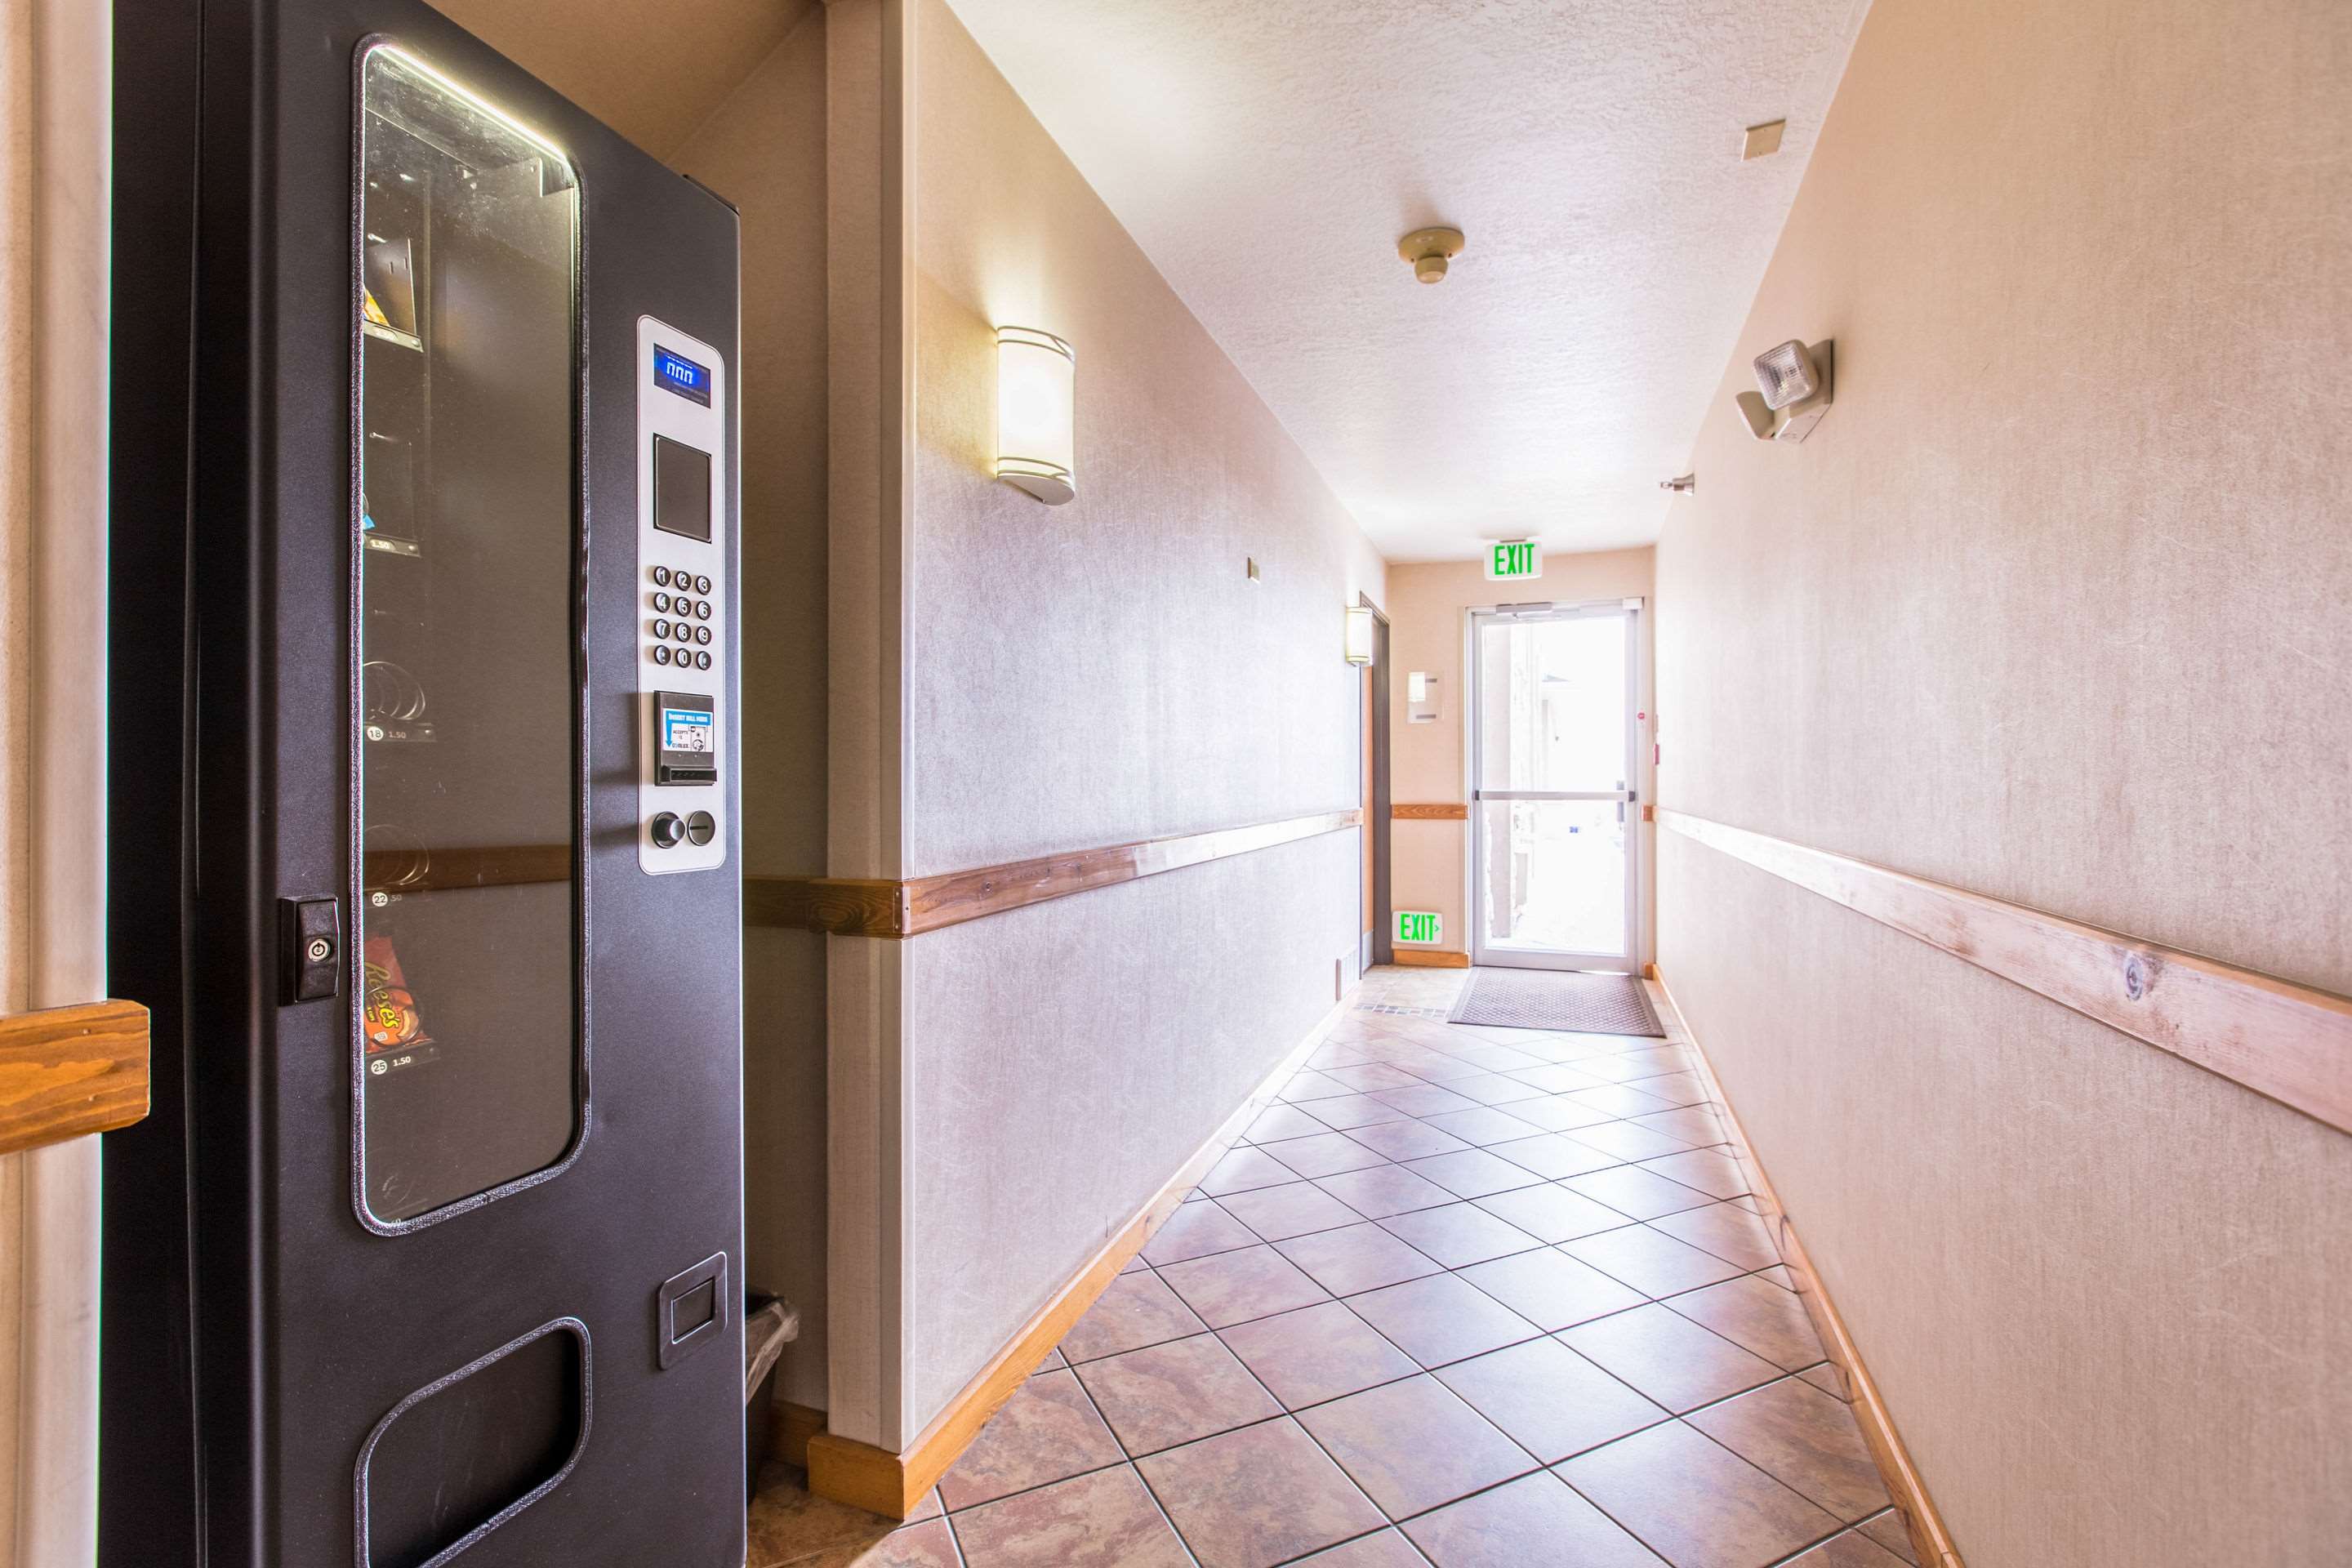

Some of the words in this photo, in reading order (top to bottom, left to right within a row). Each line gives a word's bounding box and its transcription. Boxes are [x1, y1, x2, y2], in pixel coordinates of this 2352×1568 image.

[1494, 543, 1535, 576] EXIT
[659, 570, 666, 582] 1
[681, 574, 688, 586] 2
[701, 579, 708, 591] 3
[660, 597, 667, 609] 4
[681, 601, 688, 613] 5
[702, 605, 708, 617] 6
[660, 623, 667, 635] 7
[681, 626, 688, 639] 8
[702, 630, 708, 642] 9
[681, 653, 688, 664] 0
[369, 729, 381, 738] 18
[388, 731, 407, 739] 1.50
[373, 895, 386, 904] 22
[1400, 913, 1437, 942] EXIT
[372, 1062, 386, 1072] 25
[393, 1055, 412, 1067] 1.50
